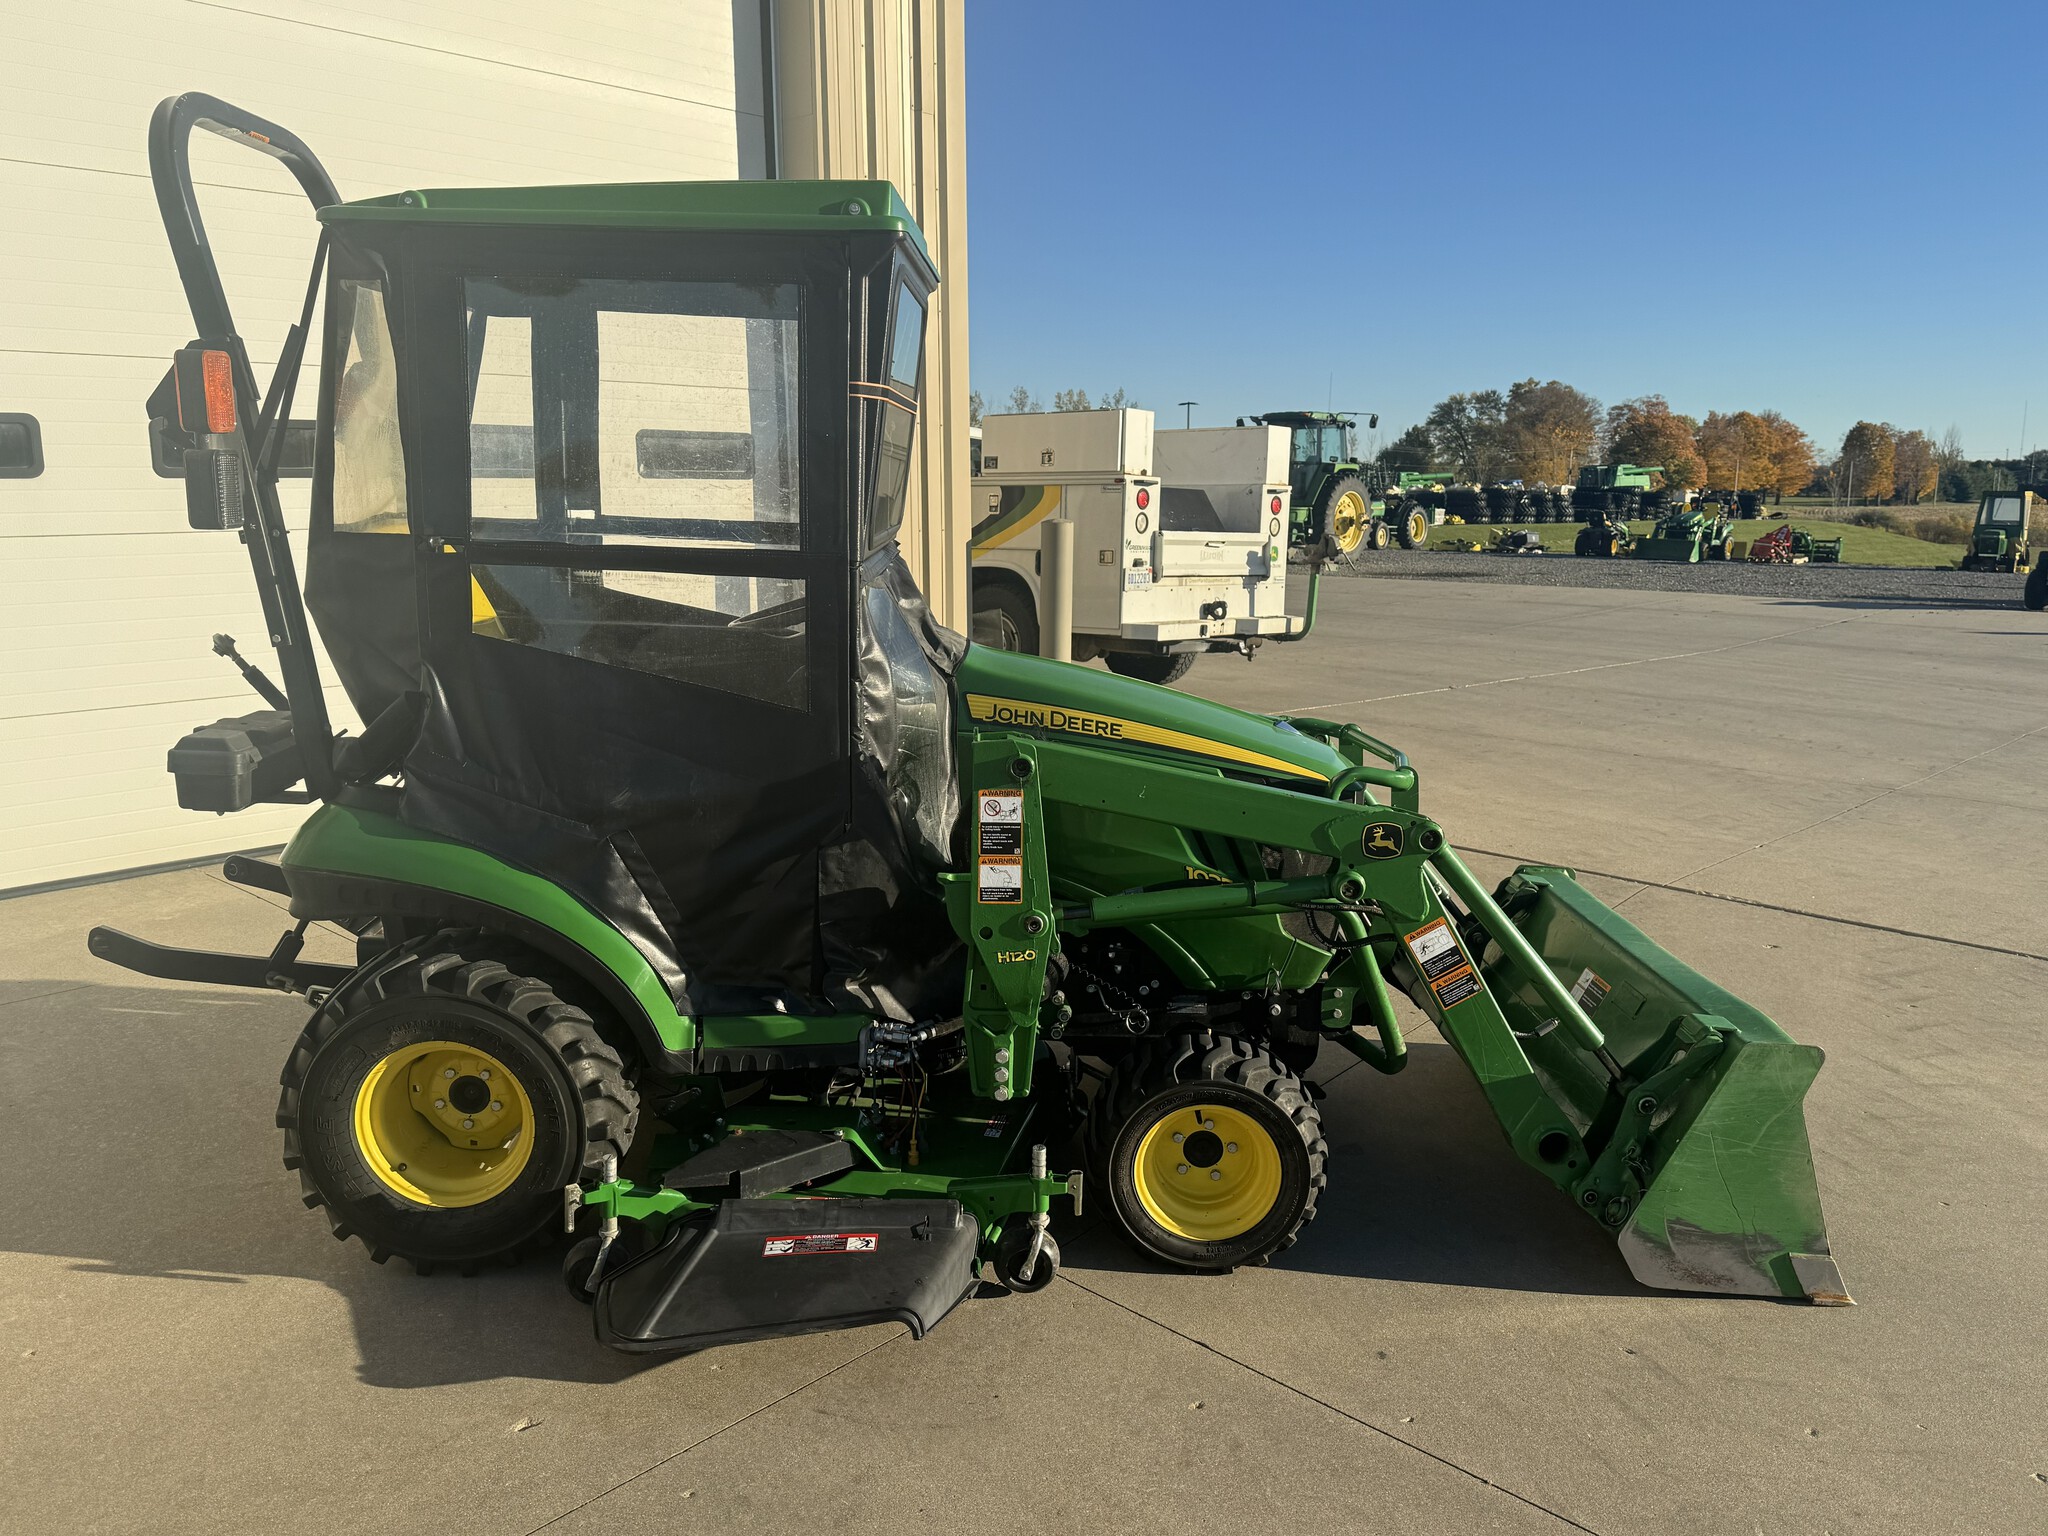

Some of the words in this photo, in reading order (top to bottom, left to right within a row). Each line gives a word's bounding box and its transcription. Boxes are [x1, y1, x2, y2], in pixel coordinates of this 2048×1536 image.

[985, 704, 1045, 726] JOHN
[1050, 710, 1123, 737] DEERE
[987, 857, 1021, 865] WARNING
[1414, 920, 1441, 937] WARNING
[997, 949, 1036, 964] H120
[1442, 968, 1468, 985] WARNING
